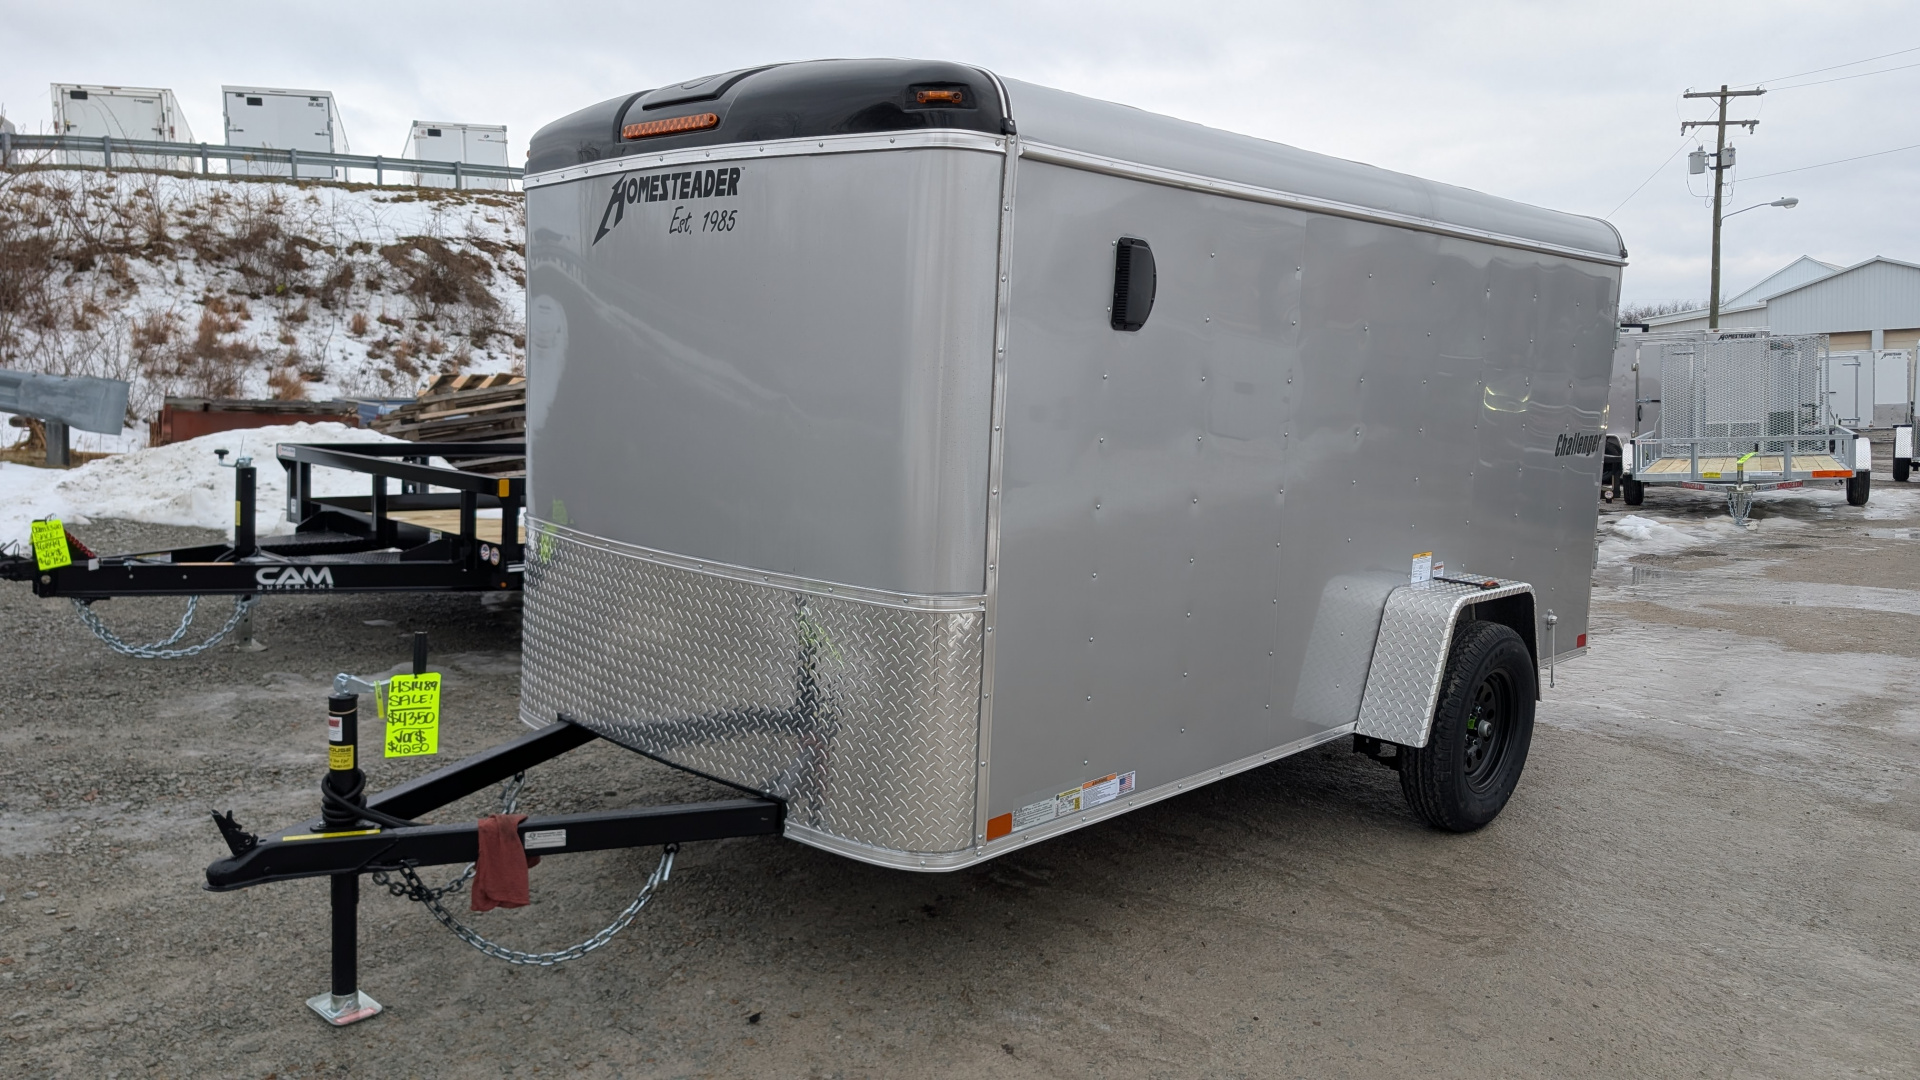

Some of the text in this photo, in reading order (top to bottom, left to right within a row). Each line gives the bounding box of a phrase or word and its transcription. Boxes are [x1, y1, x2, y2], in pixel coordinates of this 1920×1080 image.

[592, 167, 741, 247] HOMESTEADER
[702, 209, 738, 233] 1985
[1554, 432, 1603, 457] Challenger
[255, 566, 334, 585] CAM
[390, 680, 438, 693] HS1489
[388, 694, 433, 707] SALE!
[387, 711, 436, 727] $4350
[387, 740, 430, 754] $4250
